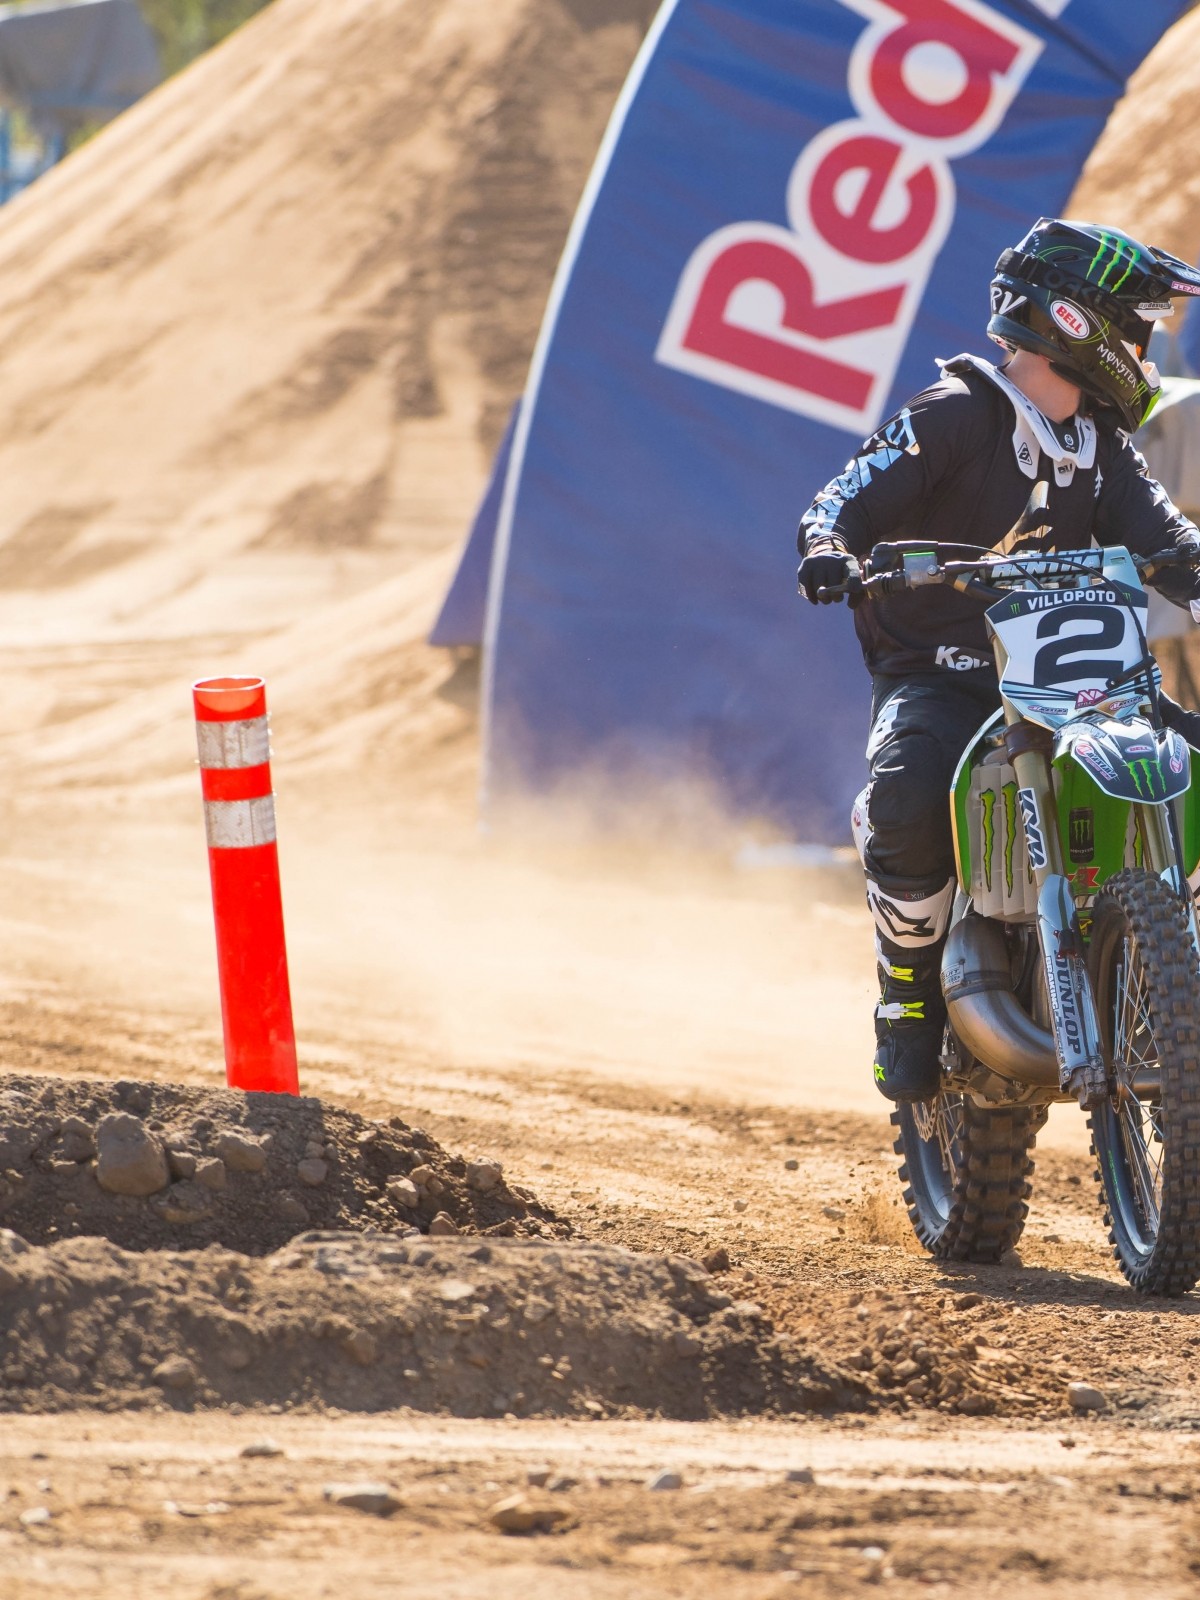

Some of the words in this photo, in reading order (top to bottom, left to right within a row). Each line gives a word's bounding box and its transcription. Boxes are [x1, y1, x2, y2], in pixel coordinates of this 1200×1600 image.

[680, 0, 1025, 414] Red
[1055, 305, 1083, 335] BELL
[1099, 361, 1129, 388] ENERGY
[1027, 590, 1116, 611] VILLOPOTO
[1034, 604, 1125, 688] 2
[1046, 955, 1060, 1011] BRAKING
[1053, 949, 1082, 1055] DUNLOP
